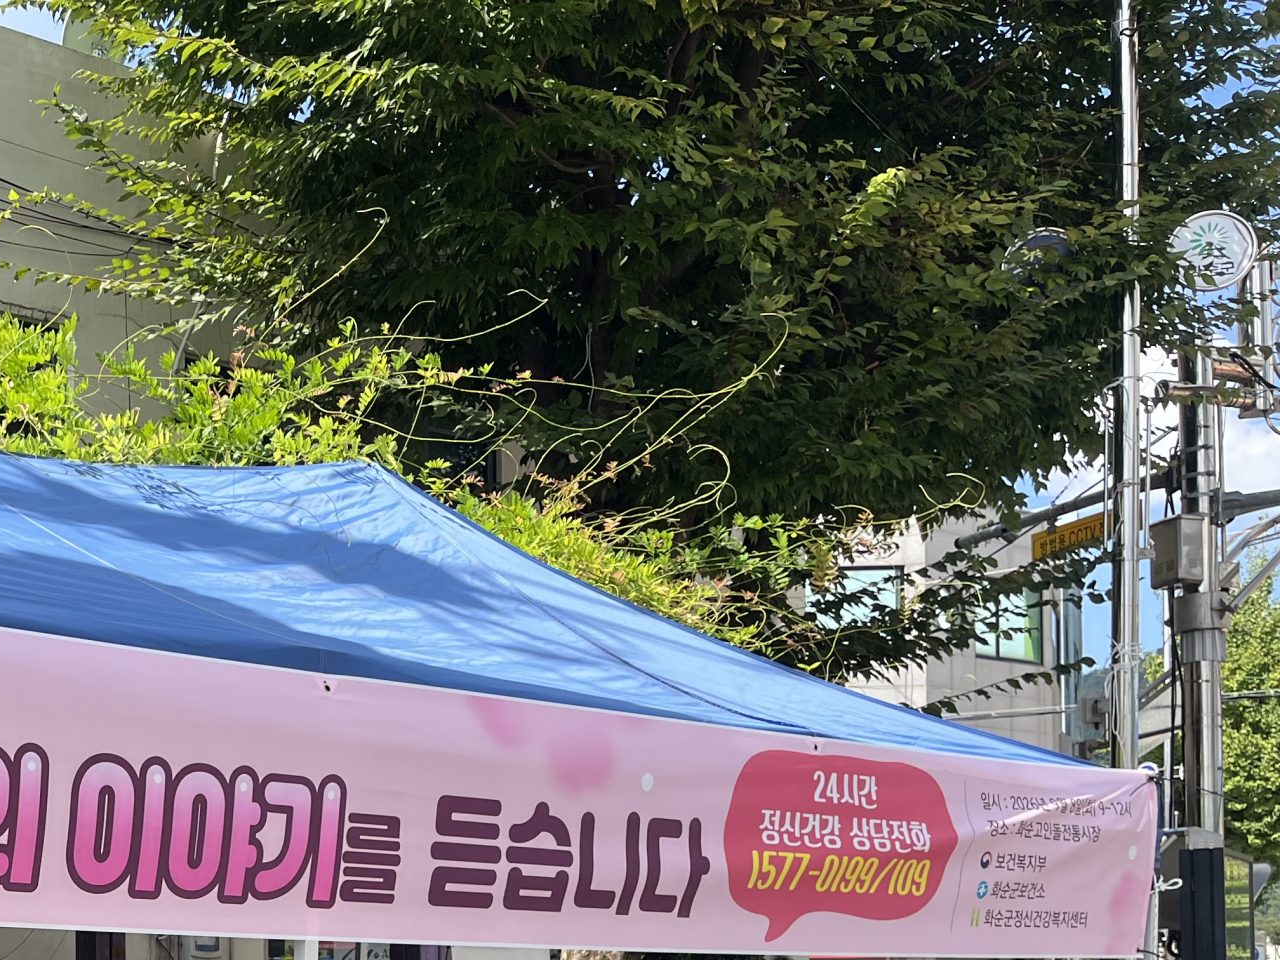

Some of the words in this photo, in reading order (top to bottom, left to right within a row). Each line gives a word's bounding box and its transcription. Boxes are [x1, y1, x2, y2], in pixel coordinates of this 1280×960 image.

[1041, 534, 1066, 556] 방범용
[1069, 523, 1096, 546] CCTV
[812, 769, 879, 811] 24시간
[980, 791, 1001, 811] 일시
[65, 751, 402, 910] 이야기를
[427, 794, 711, 918] 듣습니다
[758, 808, 843, 849] 정신건강
[848, 816, 932, 855] 상담전화
[987, 819, 1009, 837] 장소
[746, 849, 932, 897] 1577-0199/109
[994, 852, 1048, 873] 보건복지부
[990, 880, 1046, 900] 화순군보건소
[983, 908, 1089, 929] 화순군정신건강복지센터
